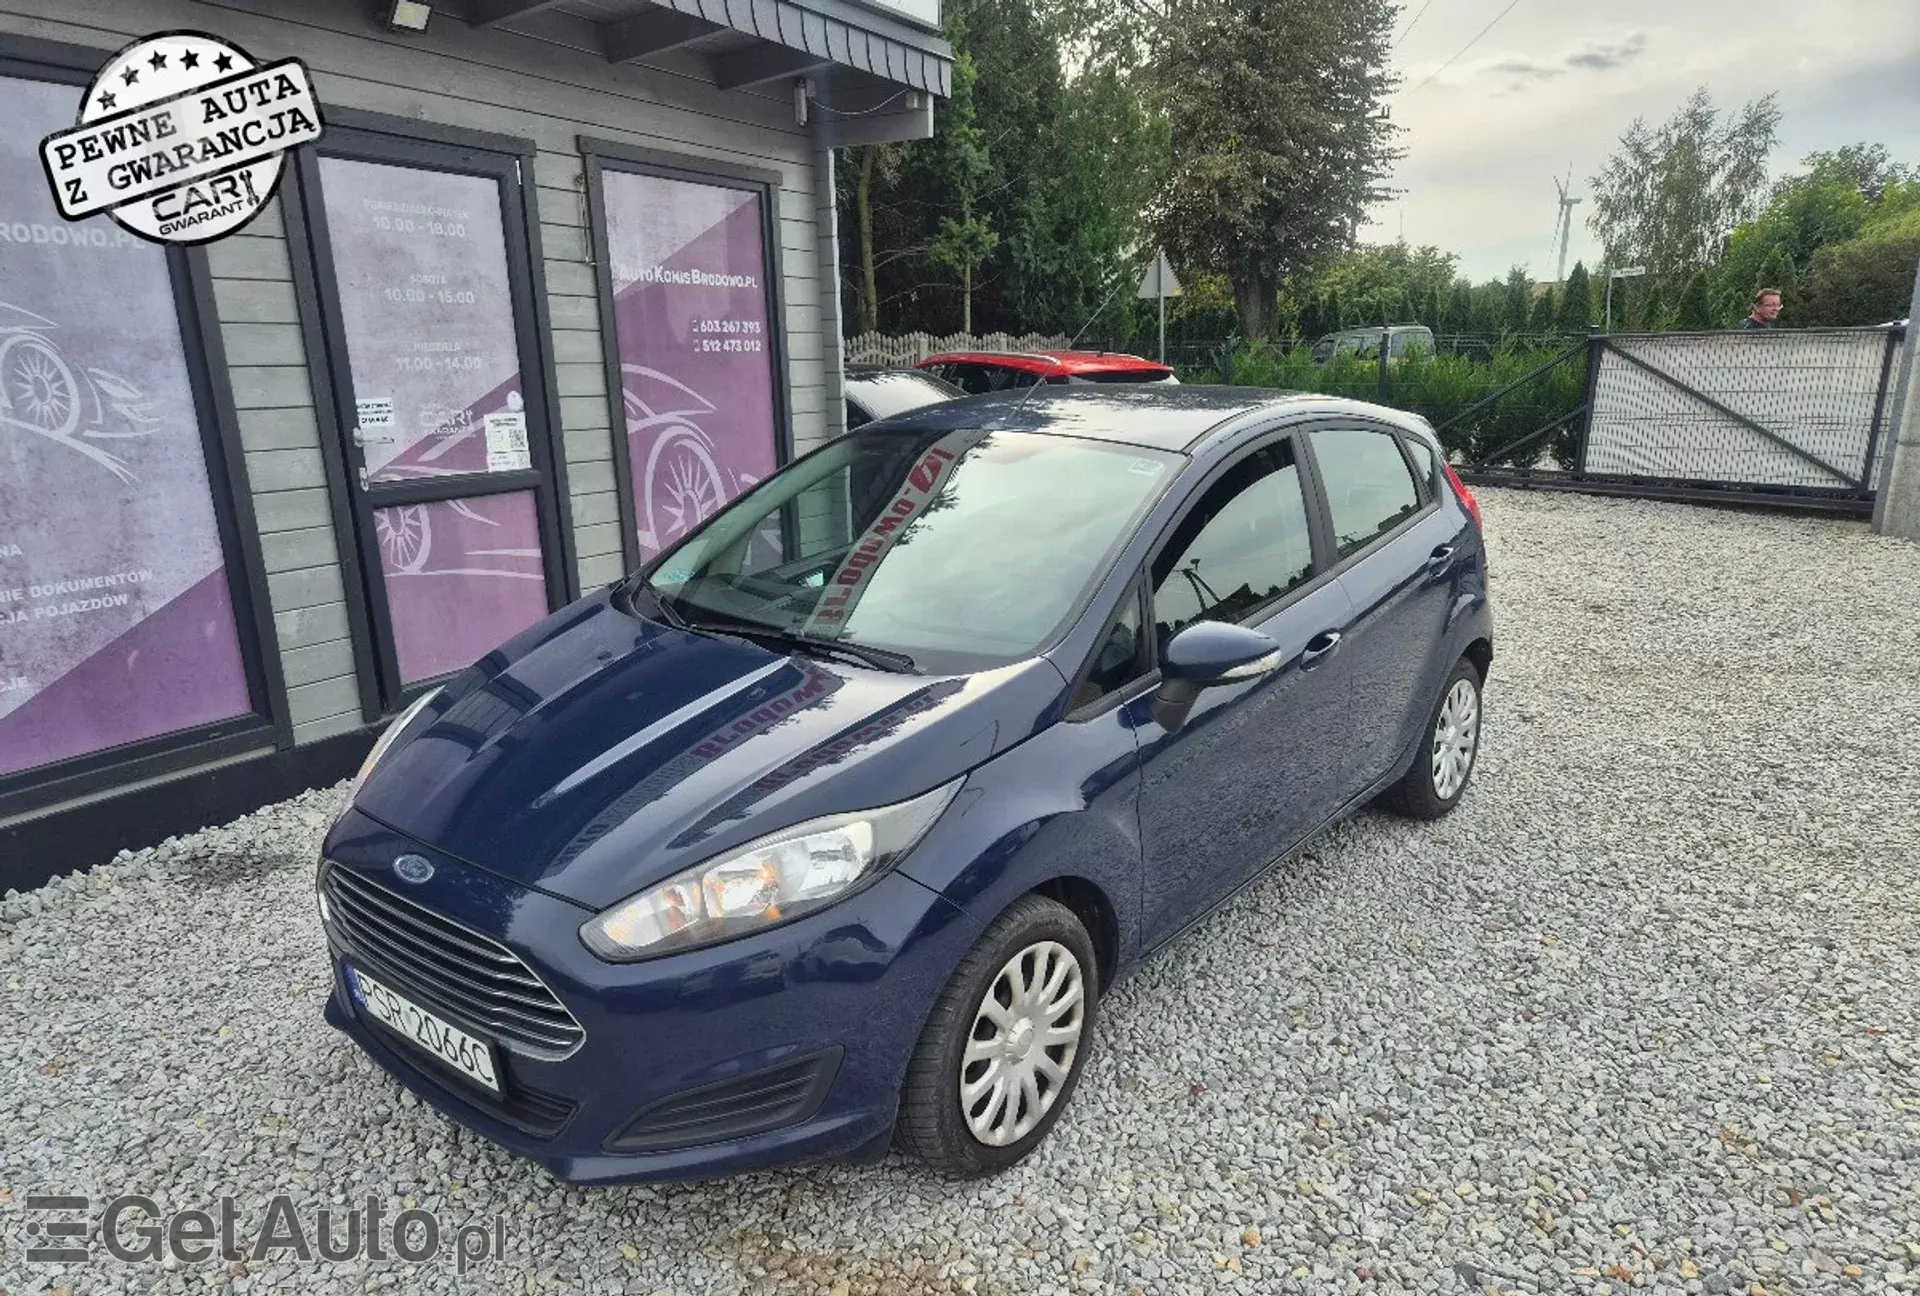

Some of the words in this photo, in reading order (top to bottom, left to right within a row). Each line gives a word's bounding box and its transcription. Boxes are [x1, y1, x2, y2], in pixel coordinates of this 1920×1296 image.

[373, 215, 414, 232] 10.00
[427, 220, 467, 237] 18.00
[437, 289, 475, 305] 15.00
[700, 319, 721, 333] 603
[722, 320, 741, 333] 267
[742, 321, 761, 334] 393
[702, 339, 721, 352] 512
[723, 340, 742, 352] 473
[744, 340, 761, 352] 012
[395, 356, 433, 371] 11.00
[444, 356, 482, 370] 14.00
[34, 593, 129, 619] POJAZDÓW
[357, 973, 407, 1033] PSR
[409, 1006, 494, 1083] 2066C
